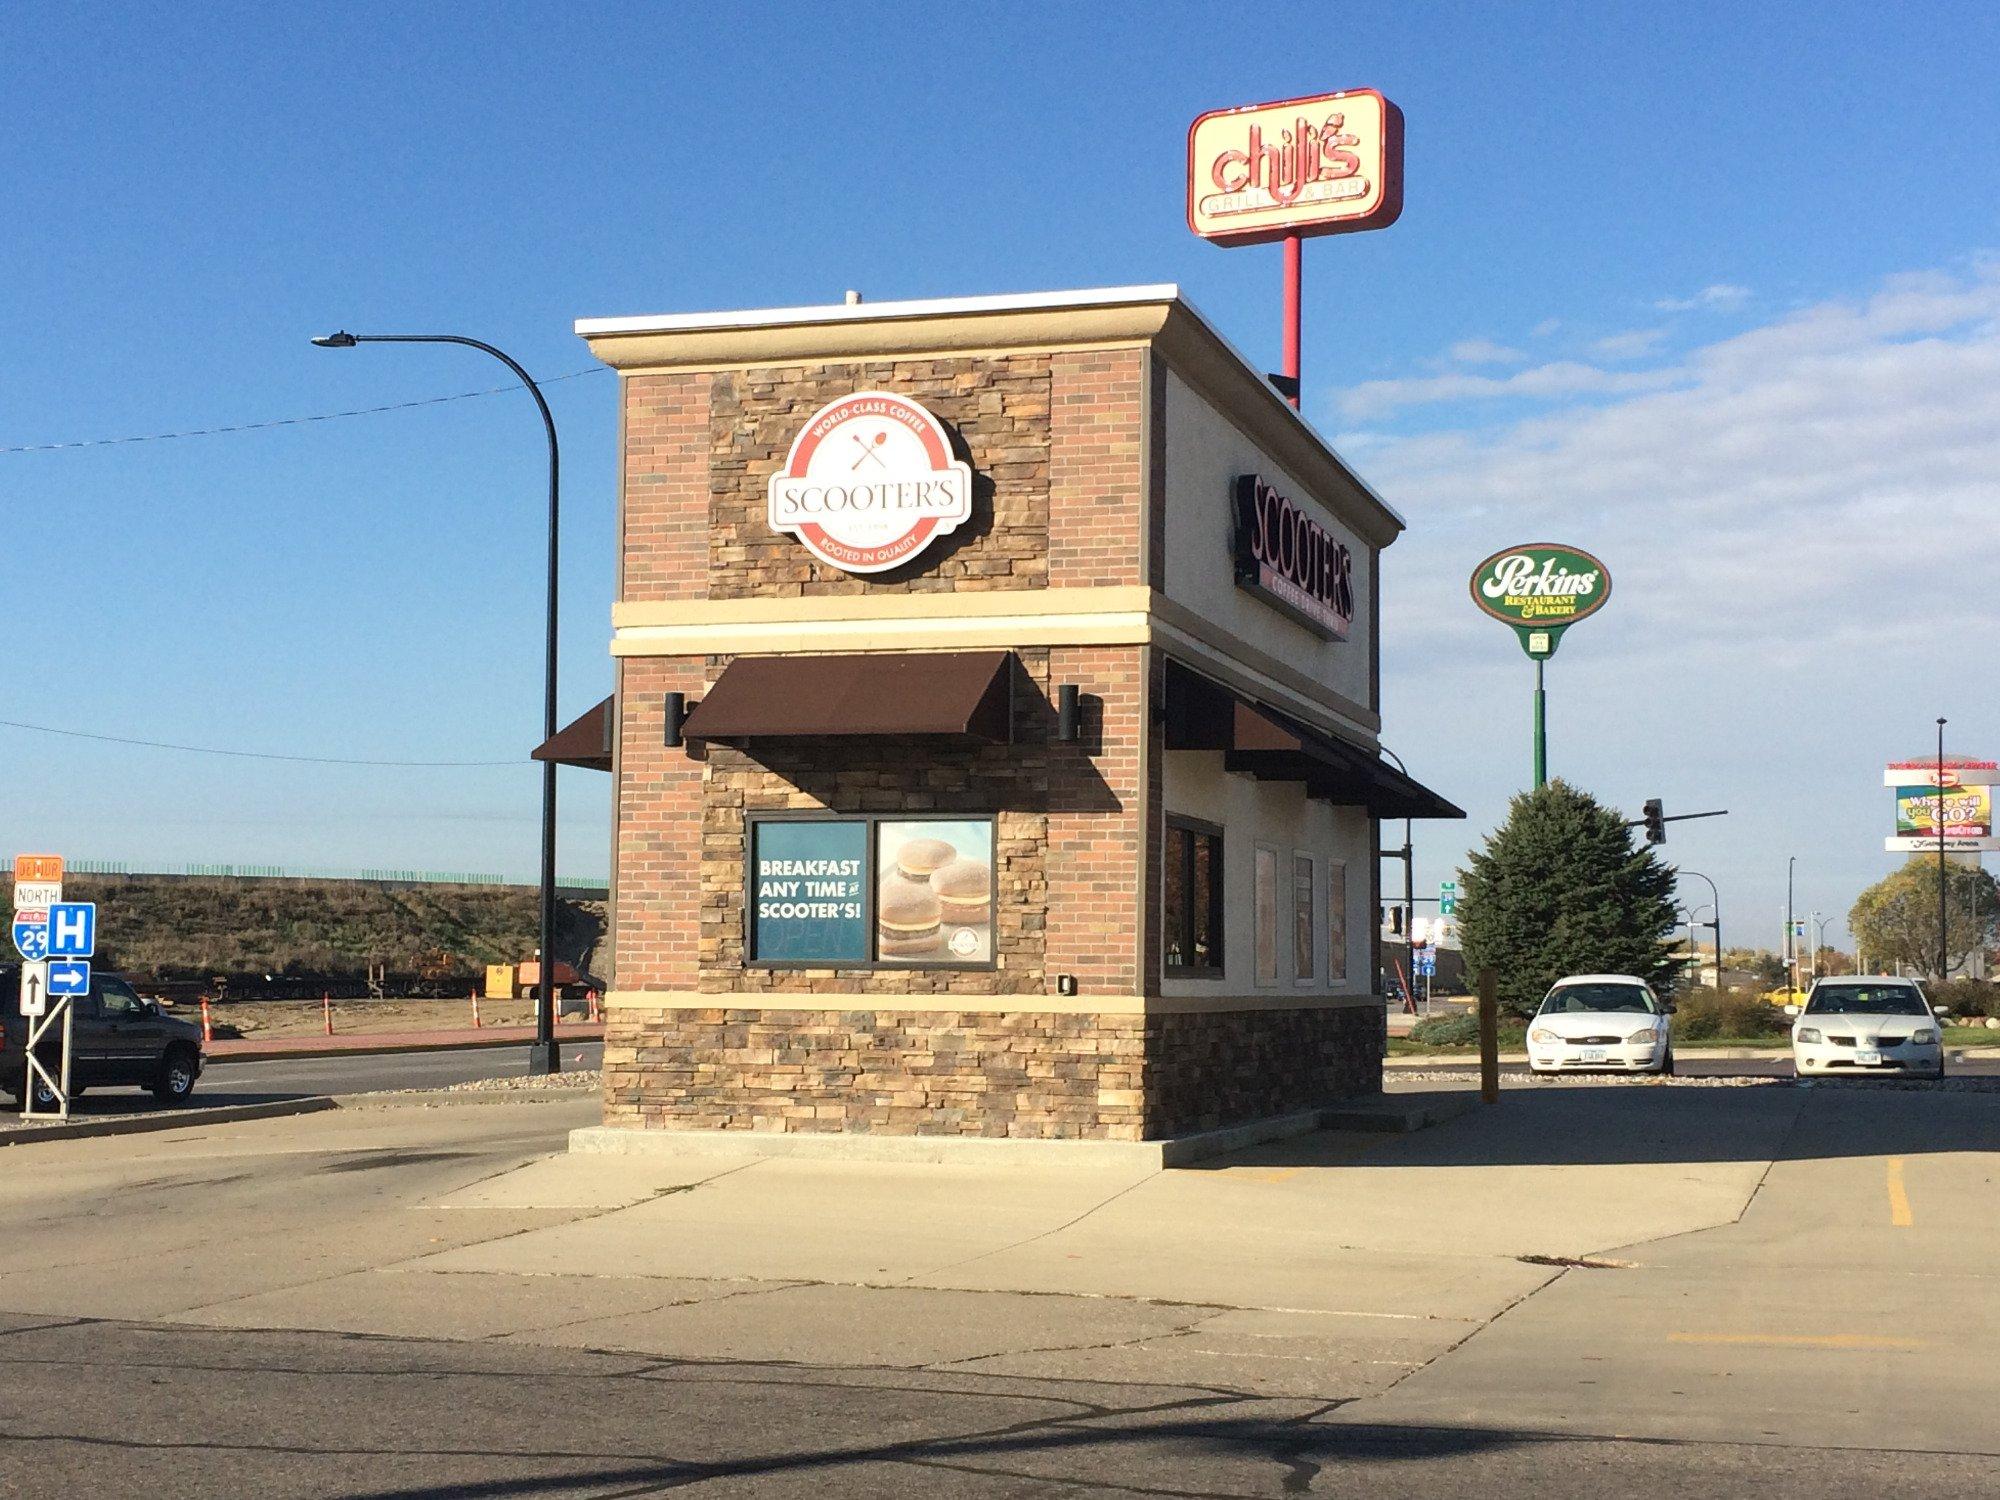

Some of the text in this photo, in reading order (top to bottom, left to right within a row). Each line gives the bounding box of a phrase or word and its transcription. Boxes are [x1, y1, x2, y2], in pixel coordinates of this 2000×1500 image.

[1212, 112, 1361, 206] chili's
[1323, 180, 1360, 197] BAR
[812, 401, 927, 439] WORLD-CLASS COFFEE
[783, 479, 955, 515] SCOOTER'S
[819, 533, 918, 563] ROOTED IN QUALITY
[1503, 596, 1577, 606] RESTAURANT
[1521, 605, 1577, 619] & BAKERY
[1906, 807, 1977, 823] you GO?
[759, 860, 861, 876] BREAKFAST
[18, 887, 58, 903] NORTH
[758, 881, 800, 898] ANY
[804, 881, 847, 898] TIME
[758, 902, 862, 919] SCOOTER'S!
[57, 911, 86, 950] H
[22, 930, 48, 951] 29
